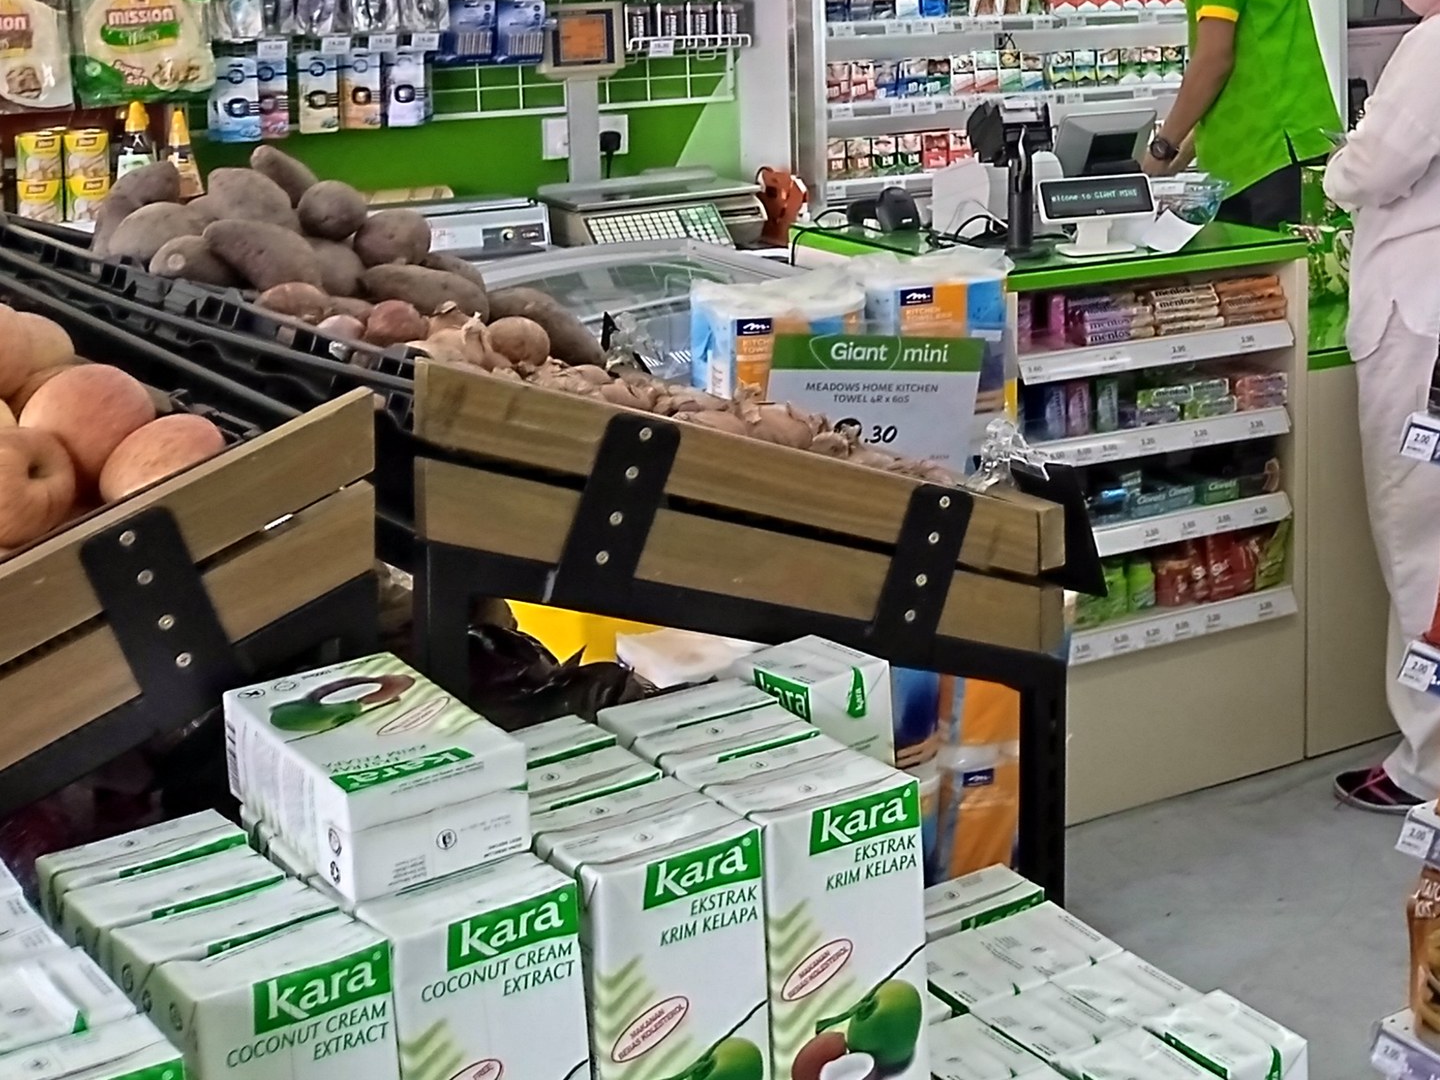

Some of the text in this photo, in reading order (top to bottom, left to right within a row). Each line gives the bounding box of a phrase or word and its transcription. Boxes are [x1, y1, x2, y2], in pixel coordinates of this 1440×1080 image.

[108, 7, 174, 26] mission
[112, 59, 145, 77] Super
[126, 74, 150, 88] Soft
[1093, 189, 1116, 200] GIANT
[1154, 286, 1192, 298] mentos
[1158, 297, 1196, 309] mentos
[1089, 317, 1131, 330] mentos
[1089, 329, 1132, 343] mentos
[830, 341, 950, 363] Giant mini
[805, 381, 939, 394] MEADOWS HOME KITCHEN
[1154, 386, 1191, 397] mentos
[833, 393, 869, 404] TOWEL
[1413, 431, 1431, 445] 2.00
[1167, 485, 1195, 499] Clorets
[1208, 478, 1238, 491] Clorets
[1136, 493, 1167, 505] Clorets
[1409, 661, 1429, 675] 2.00
[820, 794, 908, 846] kara
[1408, 828, 1427, 842] 2.00
[854, 832, 917, 863] EKSTRAK
[652, 845, 749, 899] kara
[825, 852, 918, 893] KRIM KELAPA
[689, 883, 758, 917] EKSTRAK
[457, 897, 567, 957] kara
[659, 905, 759, 948] KRIM KELAPA
[421, 940, 574, 1004] COCONUT CREAM
[798, 949, 831, 980] MAKANAN
[806, 945, 849, 983] KOLESTEROL
[502, 959, 576, 998] EXTRACT
[265, 958, 377, 1021] kara
[617, 1002, 686, 1061] BEBAS KOLESTEROL
[628, 1007, 665, 1040] MAKANAN
[225, 999, 388, 1069] COCONUT CREAM
[312, 1020, 389, 1062] EXTRACT
